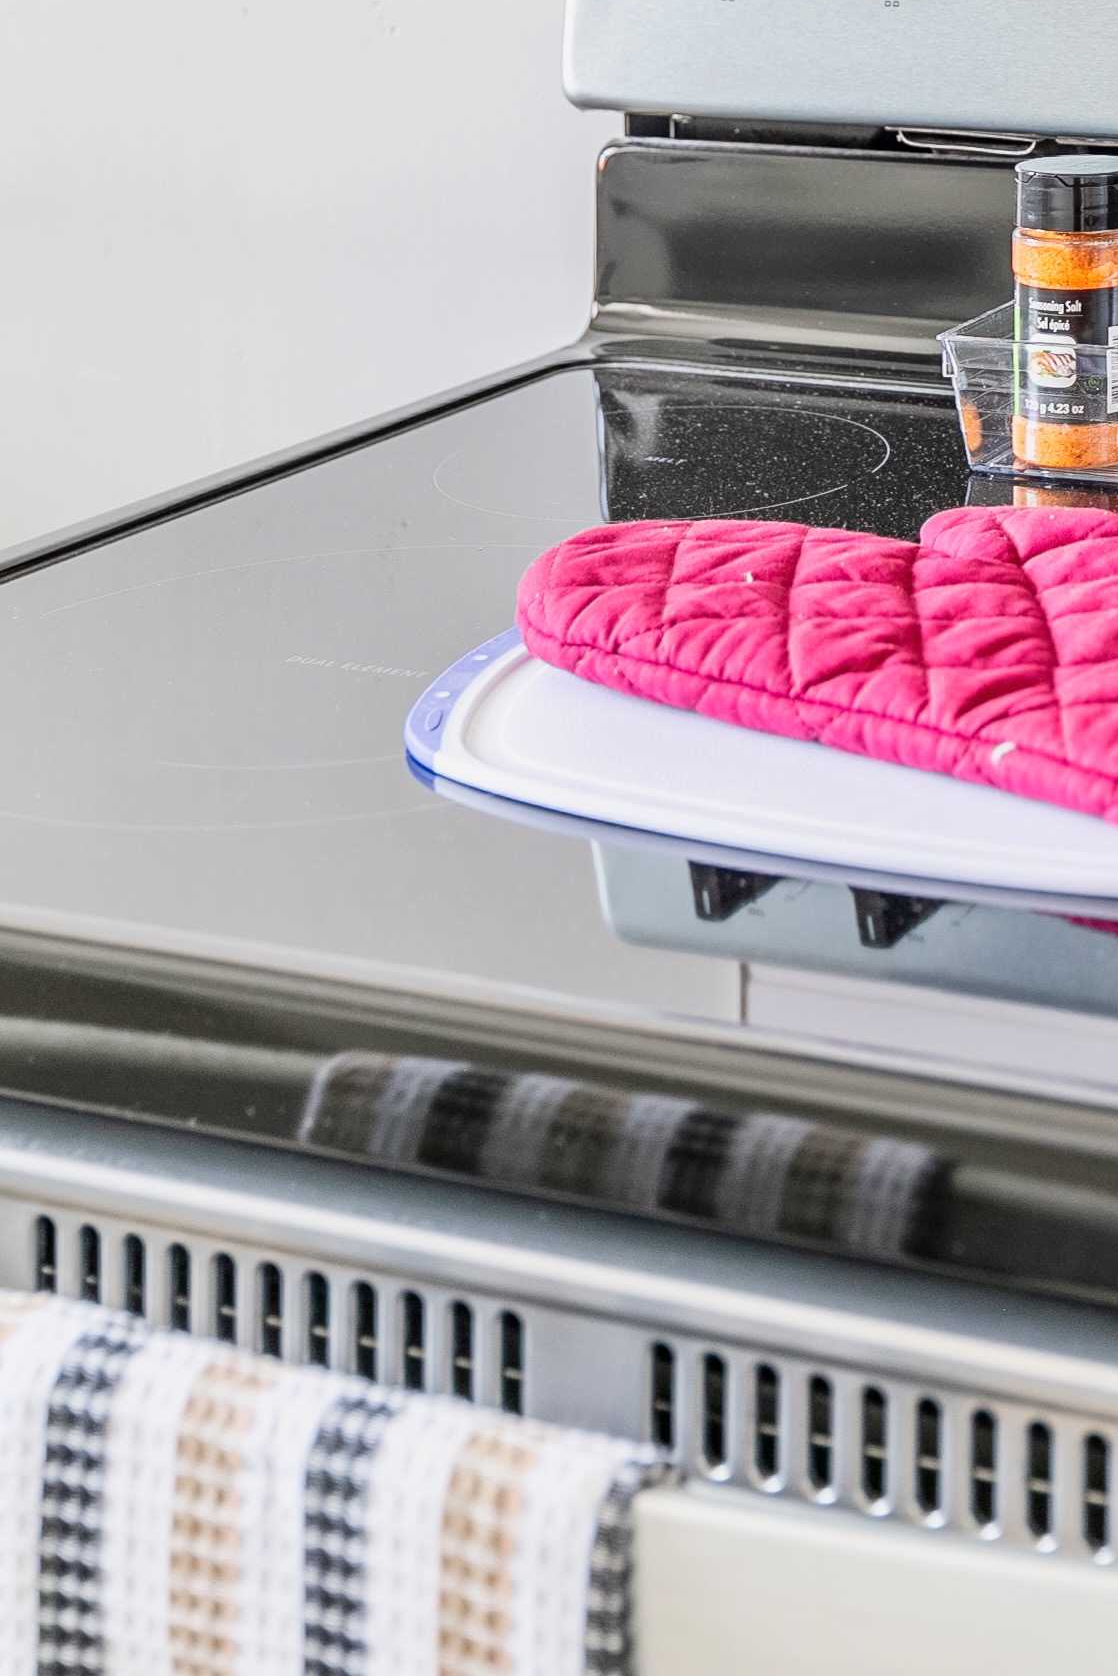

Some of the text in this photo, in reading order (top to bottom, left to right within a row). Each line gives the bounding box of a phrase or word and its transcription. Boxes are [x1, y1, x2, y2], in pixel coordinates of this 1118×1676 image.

[1028, 297, 1082, 314] Seasoning Salt
[1036, 316, 1070, 333] Sel épicé
[1047, 403, 1071, 414] 4.23
[1071, 404, 1085, 414] oz
